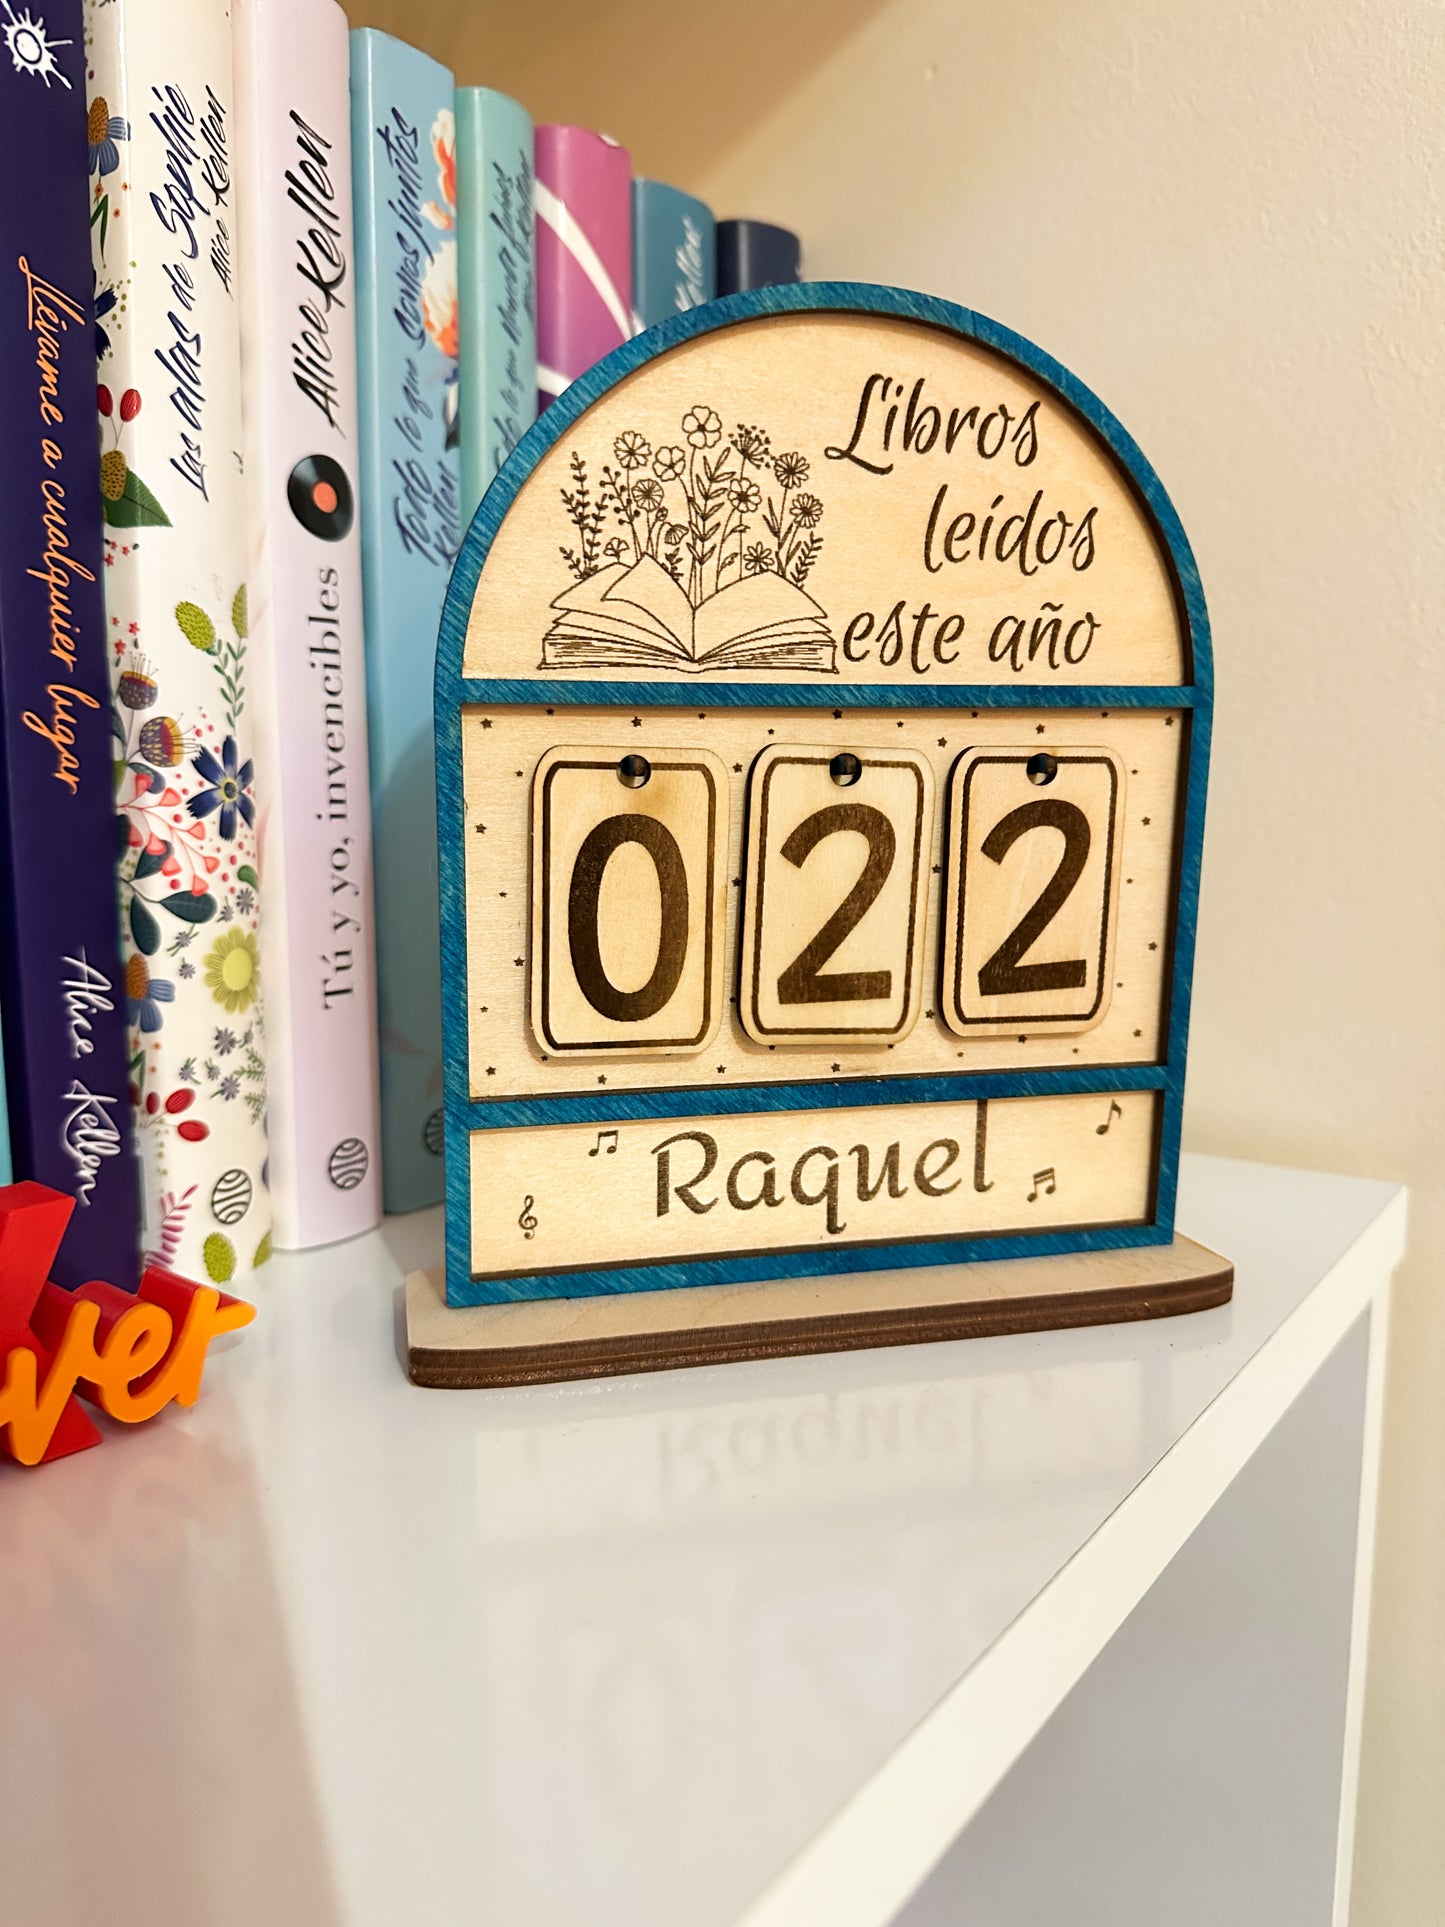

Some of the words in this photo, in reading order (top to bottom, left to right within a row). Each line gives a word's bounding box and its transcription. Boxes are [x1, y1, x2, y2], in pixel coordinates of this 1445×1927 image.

[199, 84, 231, 207] Kellen
[207, 217, 235, 301] Alice
[286, 109, 347, 309] Kellen
[19, 255, 86, 425] Llévame
[162, 262, 195, 313] de
[155, 309, 207, 431] alas
[291, 298, 347, 439] Alice
[41, 438, 62, 472] a
[170, 432, 209, 503] Las
[824, 373, 1041, 475] Libros
[392, 459, 440, 567] Todo
[924, 484, 1098, 576] leídos
[27, 480, 95, 674] cualquier
[843, 600, 965, 674] este
[988, 602, 1101, 672] año
[22, 683, 100, 796] lugar
[307, 564, 348, 824] invencibles
[331, 836, 361, 897] yo,
[319, 944, 355, 1011] Tú
[332, 912, 361, 933] y
[61, 945, 115, 1059] Alice
[62, 1078, 121, 1208] Kellen
[651, 1098, 994, 1234] Raquel
